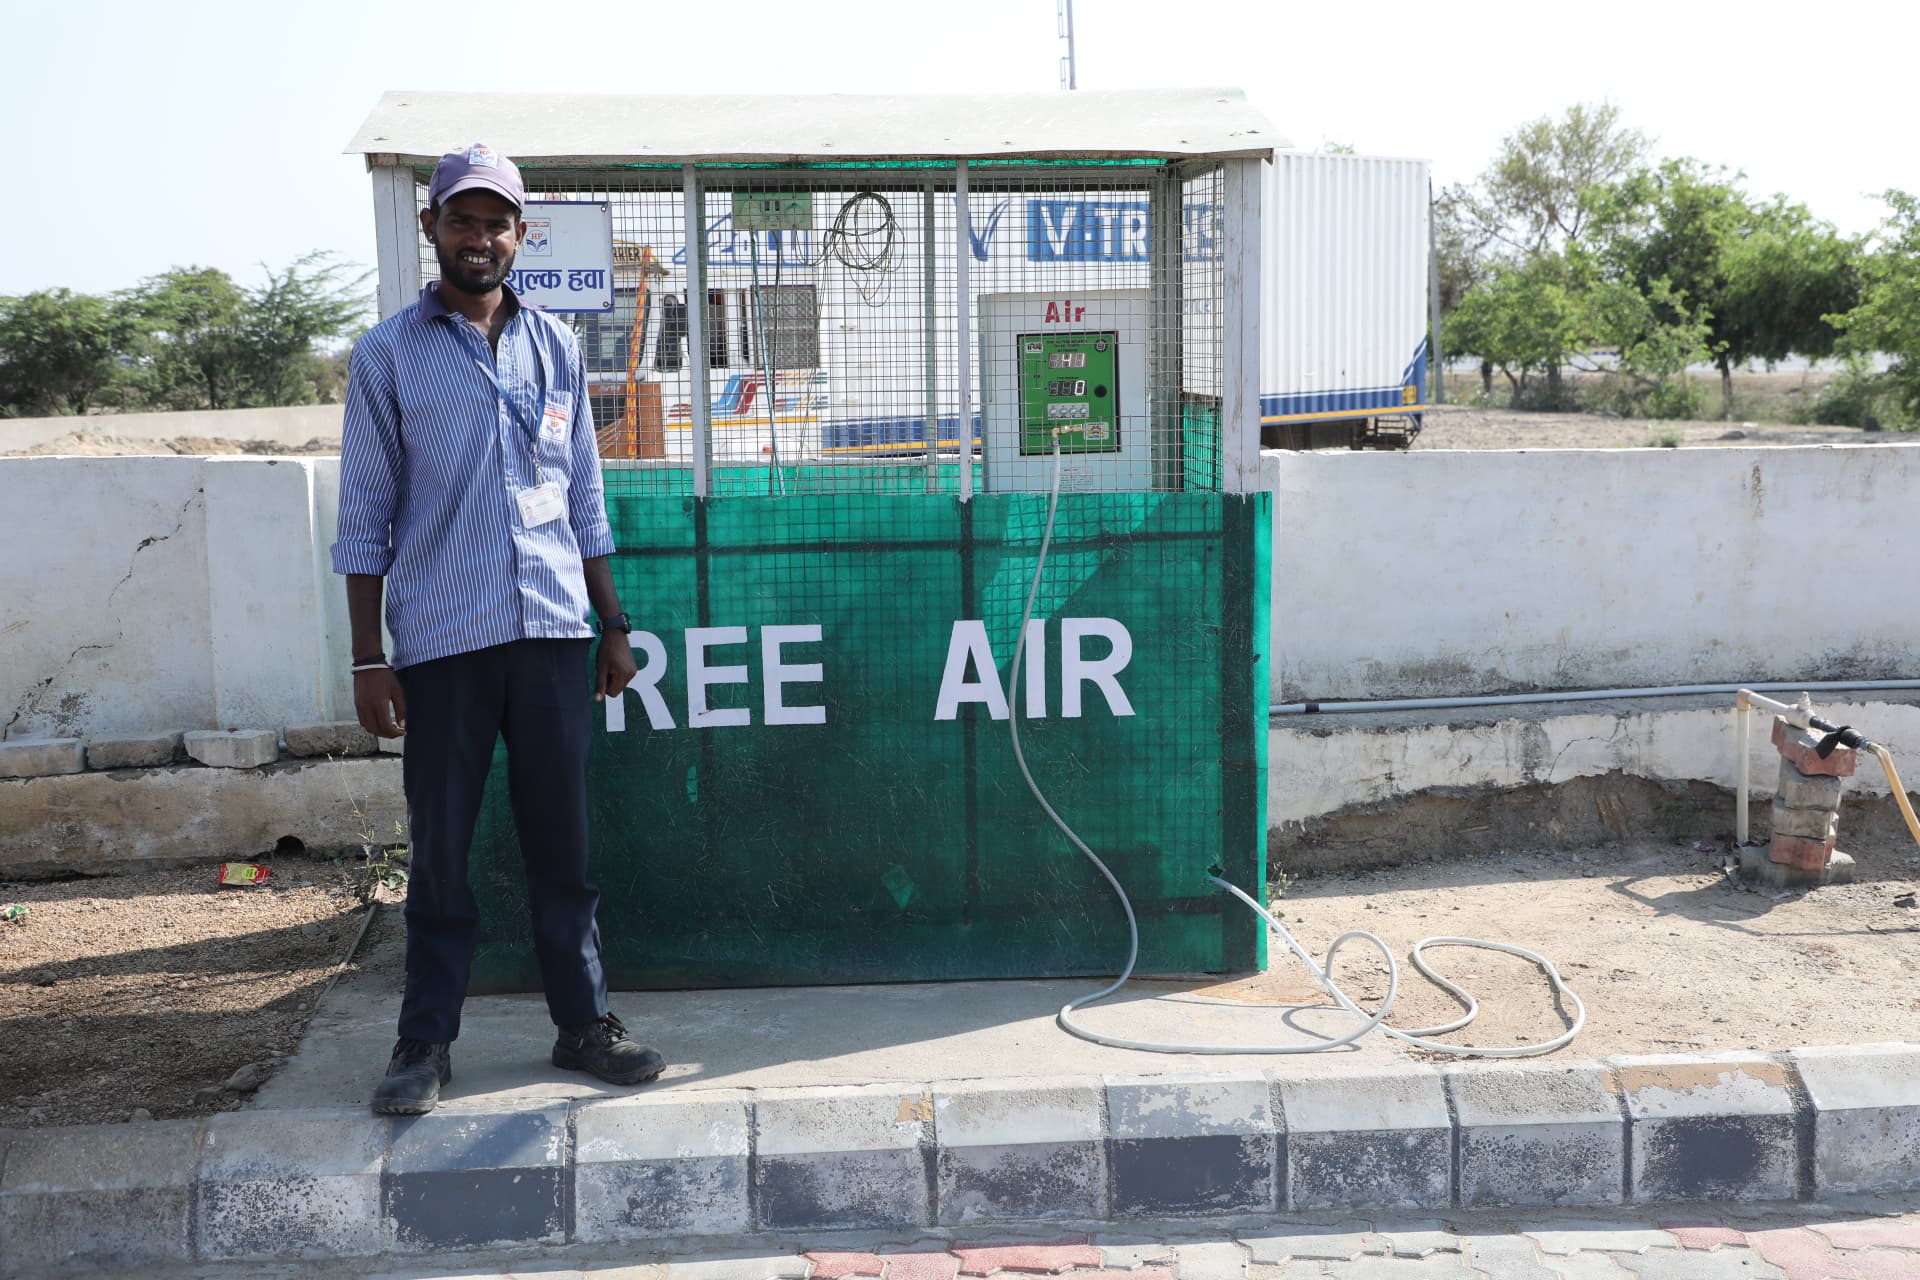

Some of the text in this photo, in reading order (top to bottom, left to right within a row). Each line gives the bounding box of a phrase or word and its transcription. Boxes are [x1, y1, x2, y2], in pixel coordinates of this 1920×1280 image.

[531, 232, 543, 240] HP
[1040, 205, 1223, 257] V-TRNS
[612, 246, 641, 262] RRIER
[505, 269, 605, 296] शुल्क हवा
[1045, 300, 1086, 323] Air
[604, 617, 1136, 732] REE AIR
